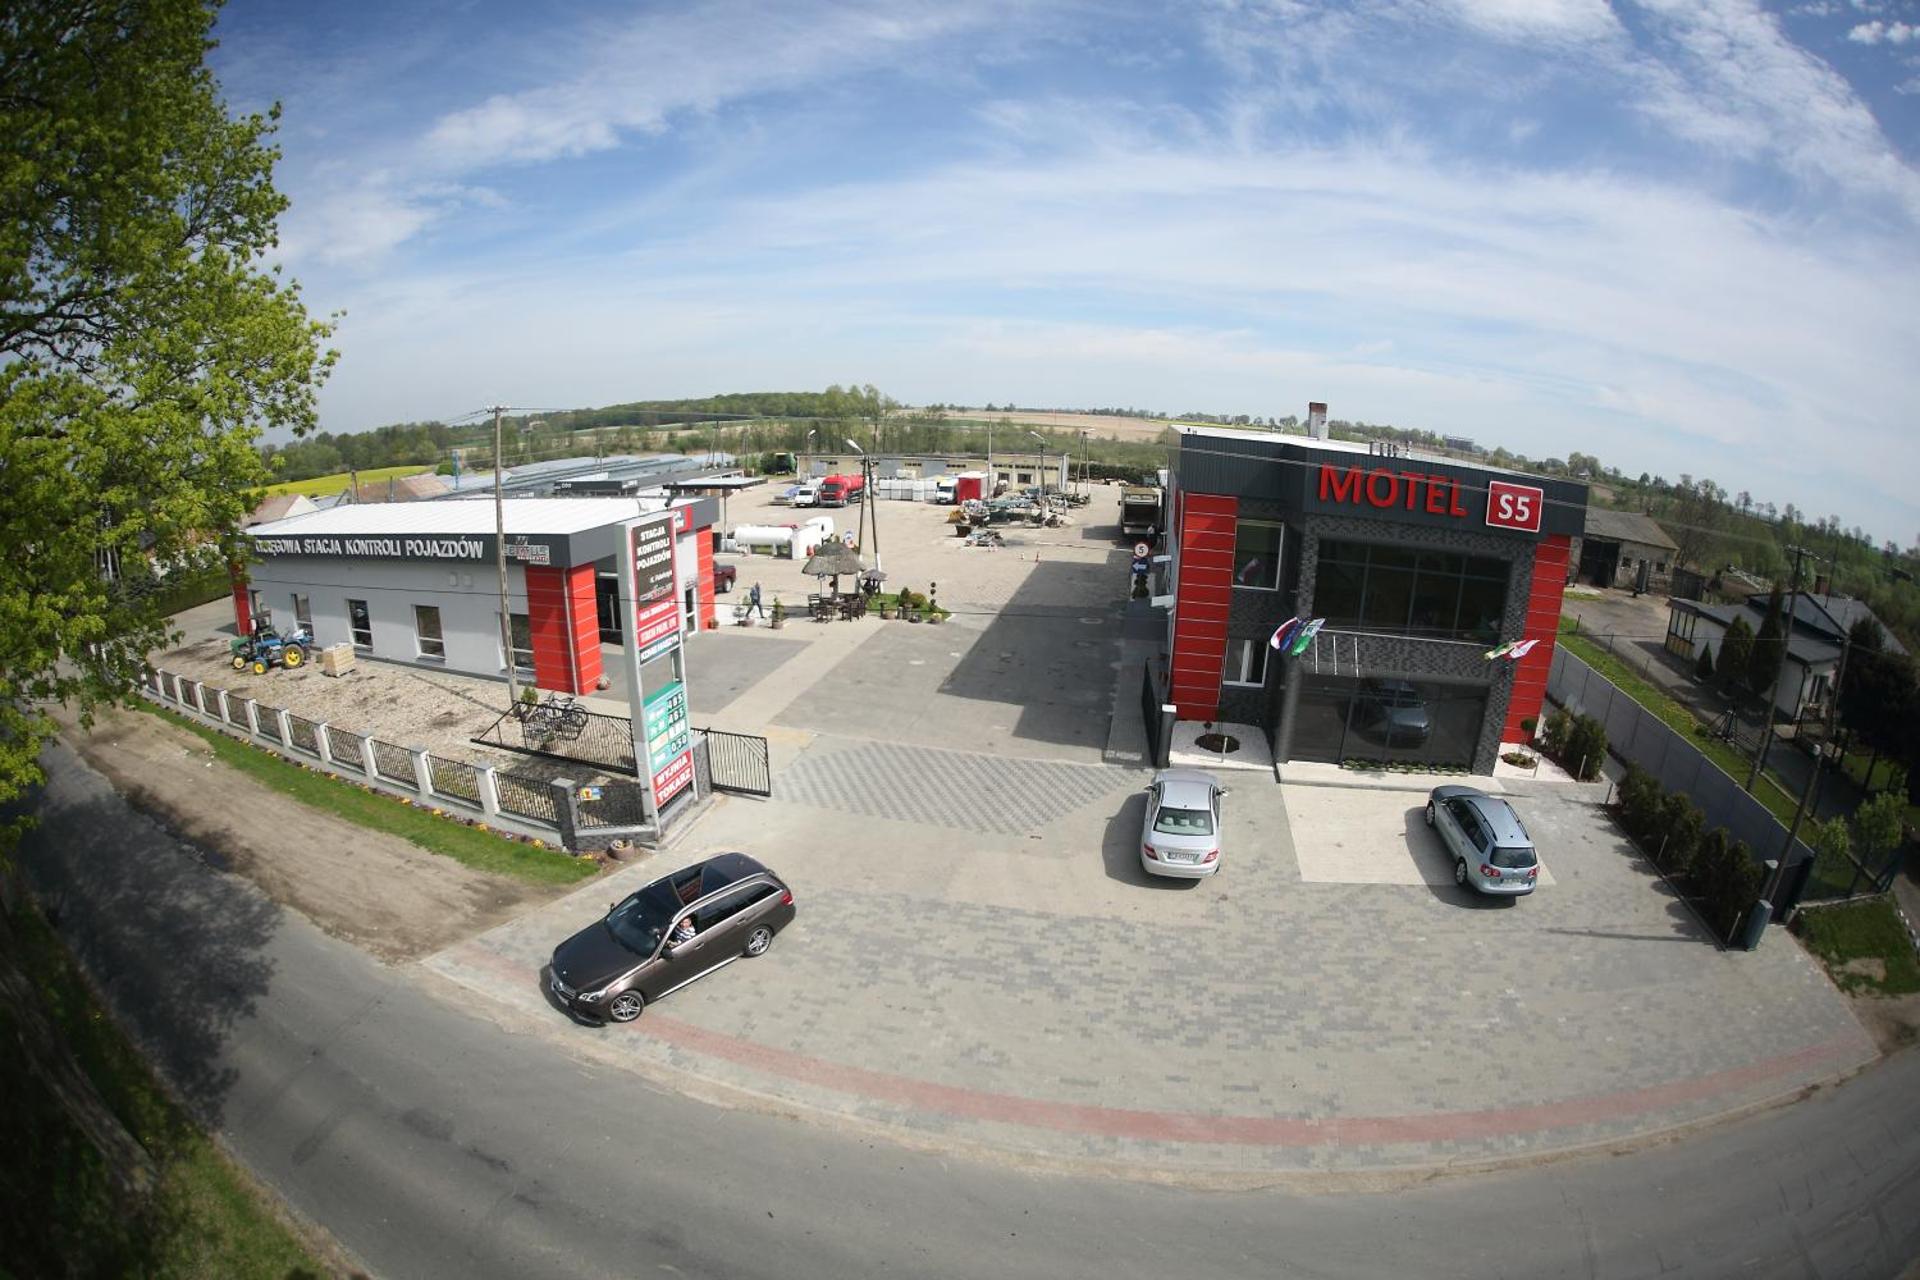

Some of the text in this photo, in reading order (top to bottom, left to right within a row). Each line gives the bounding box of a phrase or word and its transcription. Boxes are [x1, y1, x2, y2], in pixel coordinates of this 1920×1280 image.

[1319, 463, 1531, 523] MOTEL S5
[640, 526, 665, 541] STACJA
[304, 538, 342, 555] STACJA
[345, 539, 401, 557] KONTROLI
[405, 536, 484, 559] POJAZDÓW
[637, 538, 670, 556] KONTROLI
[636, 549, 672, 571] POJAZDÓW
[658, 756, 688, 785] MYJNIA
[657, 767, 692, 802] TOKARZ
